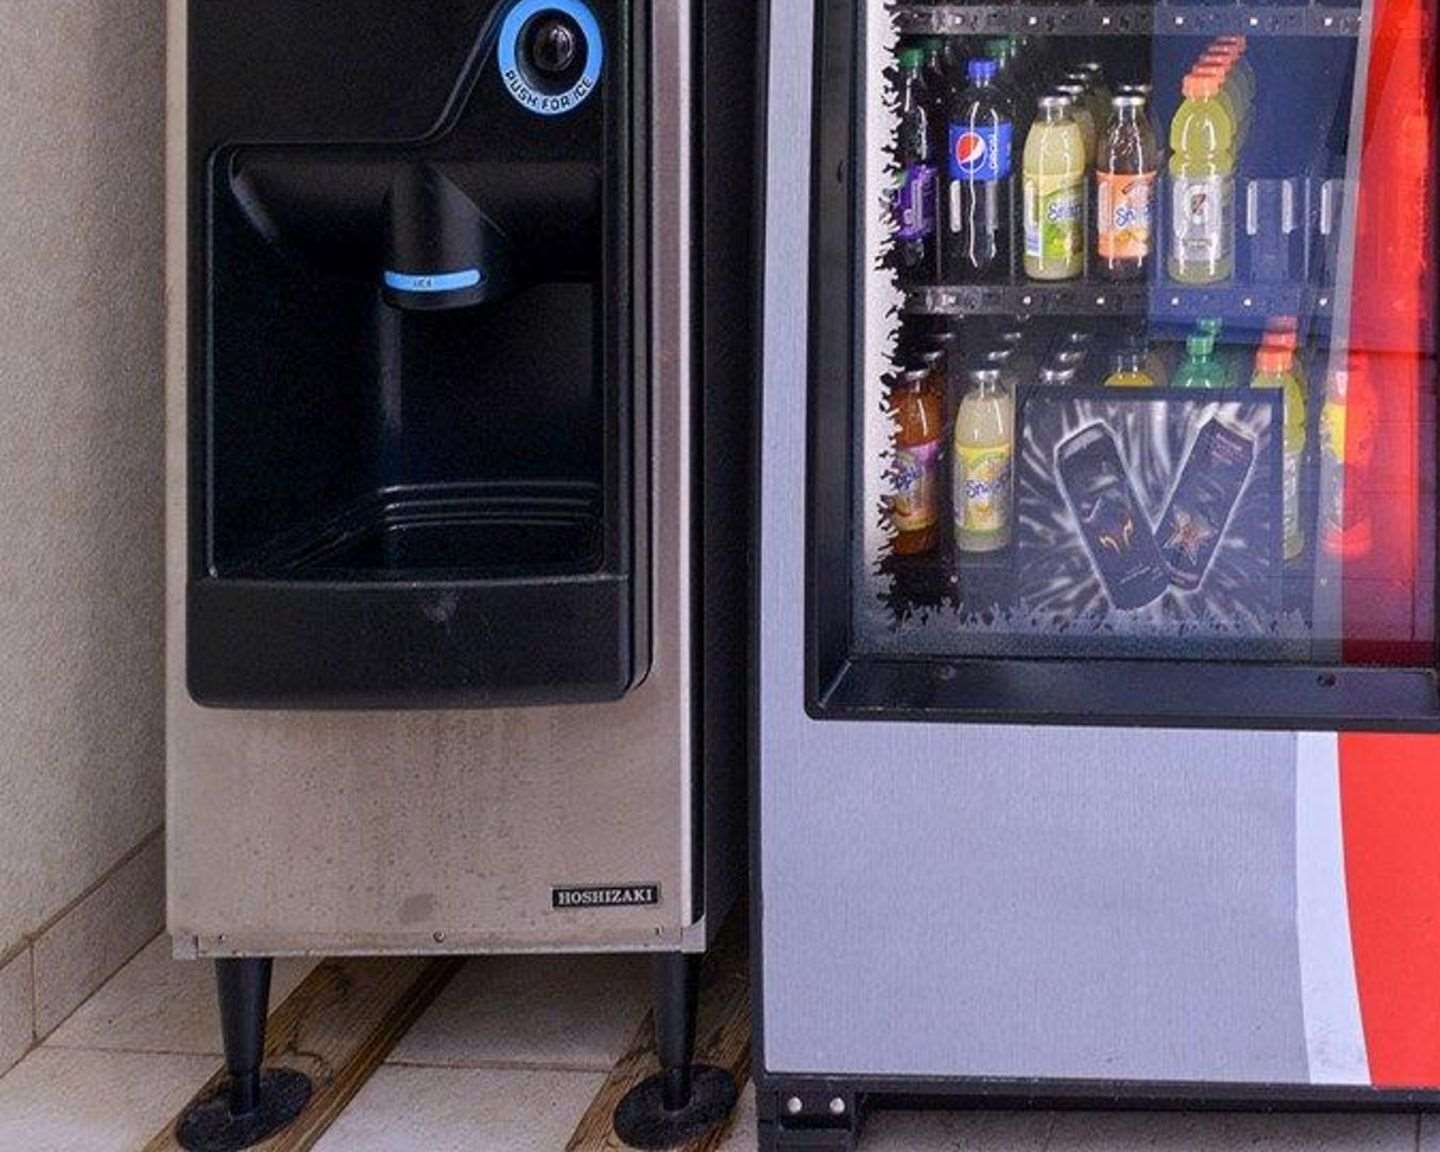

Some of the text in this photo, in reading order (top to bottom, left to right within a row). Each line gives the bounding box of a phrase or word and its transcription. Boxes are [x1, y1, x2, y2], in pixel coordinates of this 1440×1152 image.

[505, 70, 594, 111] PUSH FOR ICE
[557, 888, 653, 906] HOSHIZAKI
